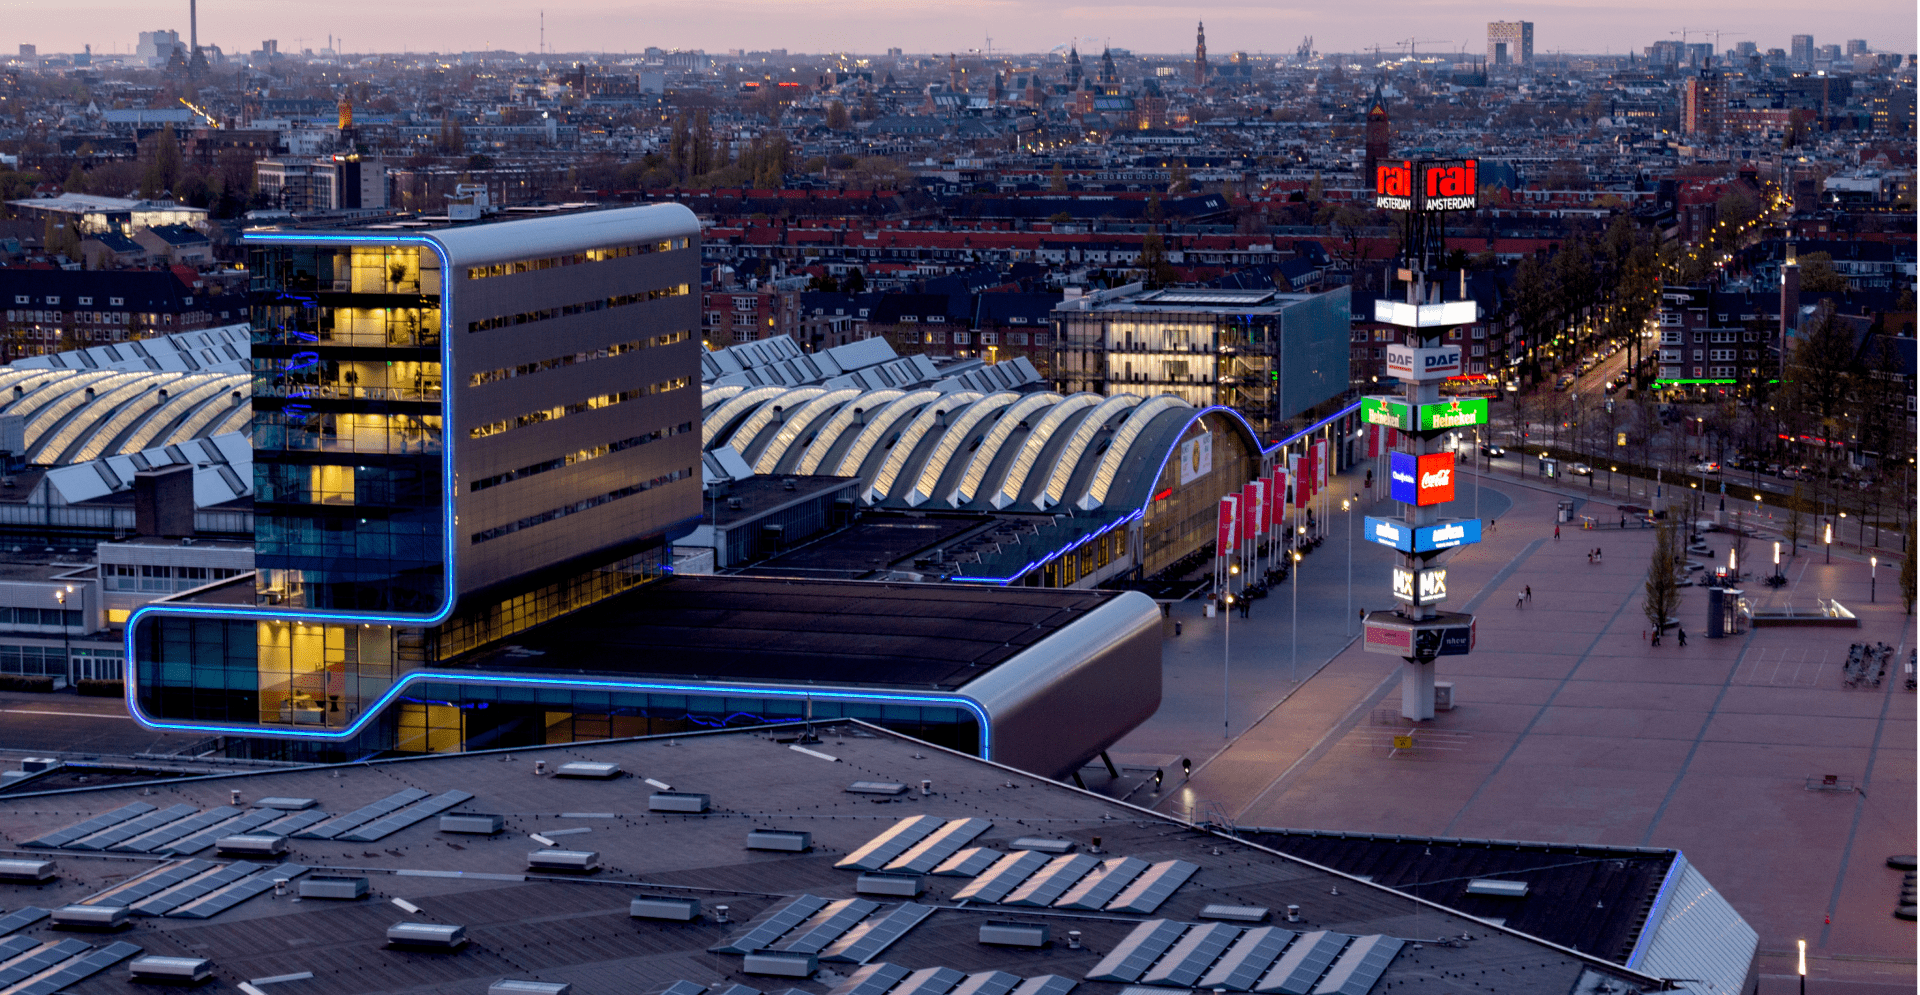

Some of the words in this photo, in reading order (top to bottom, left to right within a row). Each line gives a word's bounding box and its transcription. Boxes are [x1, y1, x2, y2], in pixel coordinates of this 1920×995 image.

[1377, 160, 1411, 196] rai
[1427, 160, 1475, 196] rai
[1377, 197, 1411, 210] AMSTERDAM
[1426, 197, 1475, 211] AMSTERDAM
[1388, 353, 1412, 366] DAF
[1425, 353, 1459, 367] DAF
[1432, 410, 1477, 428] Heineken
